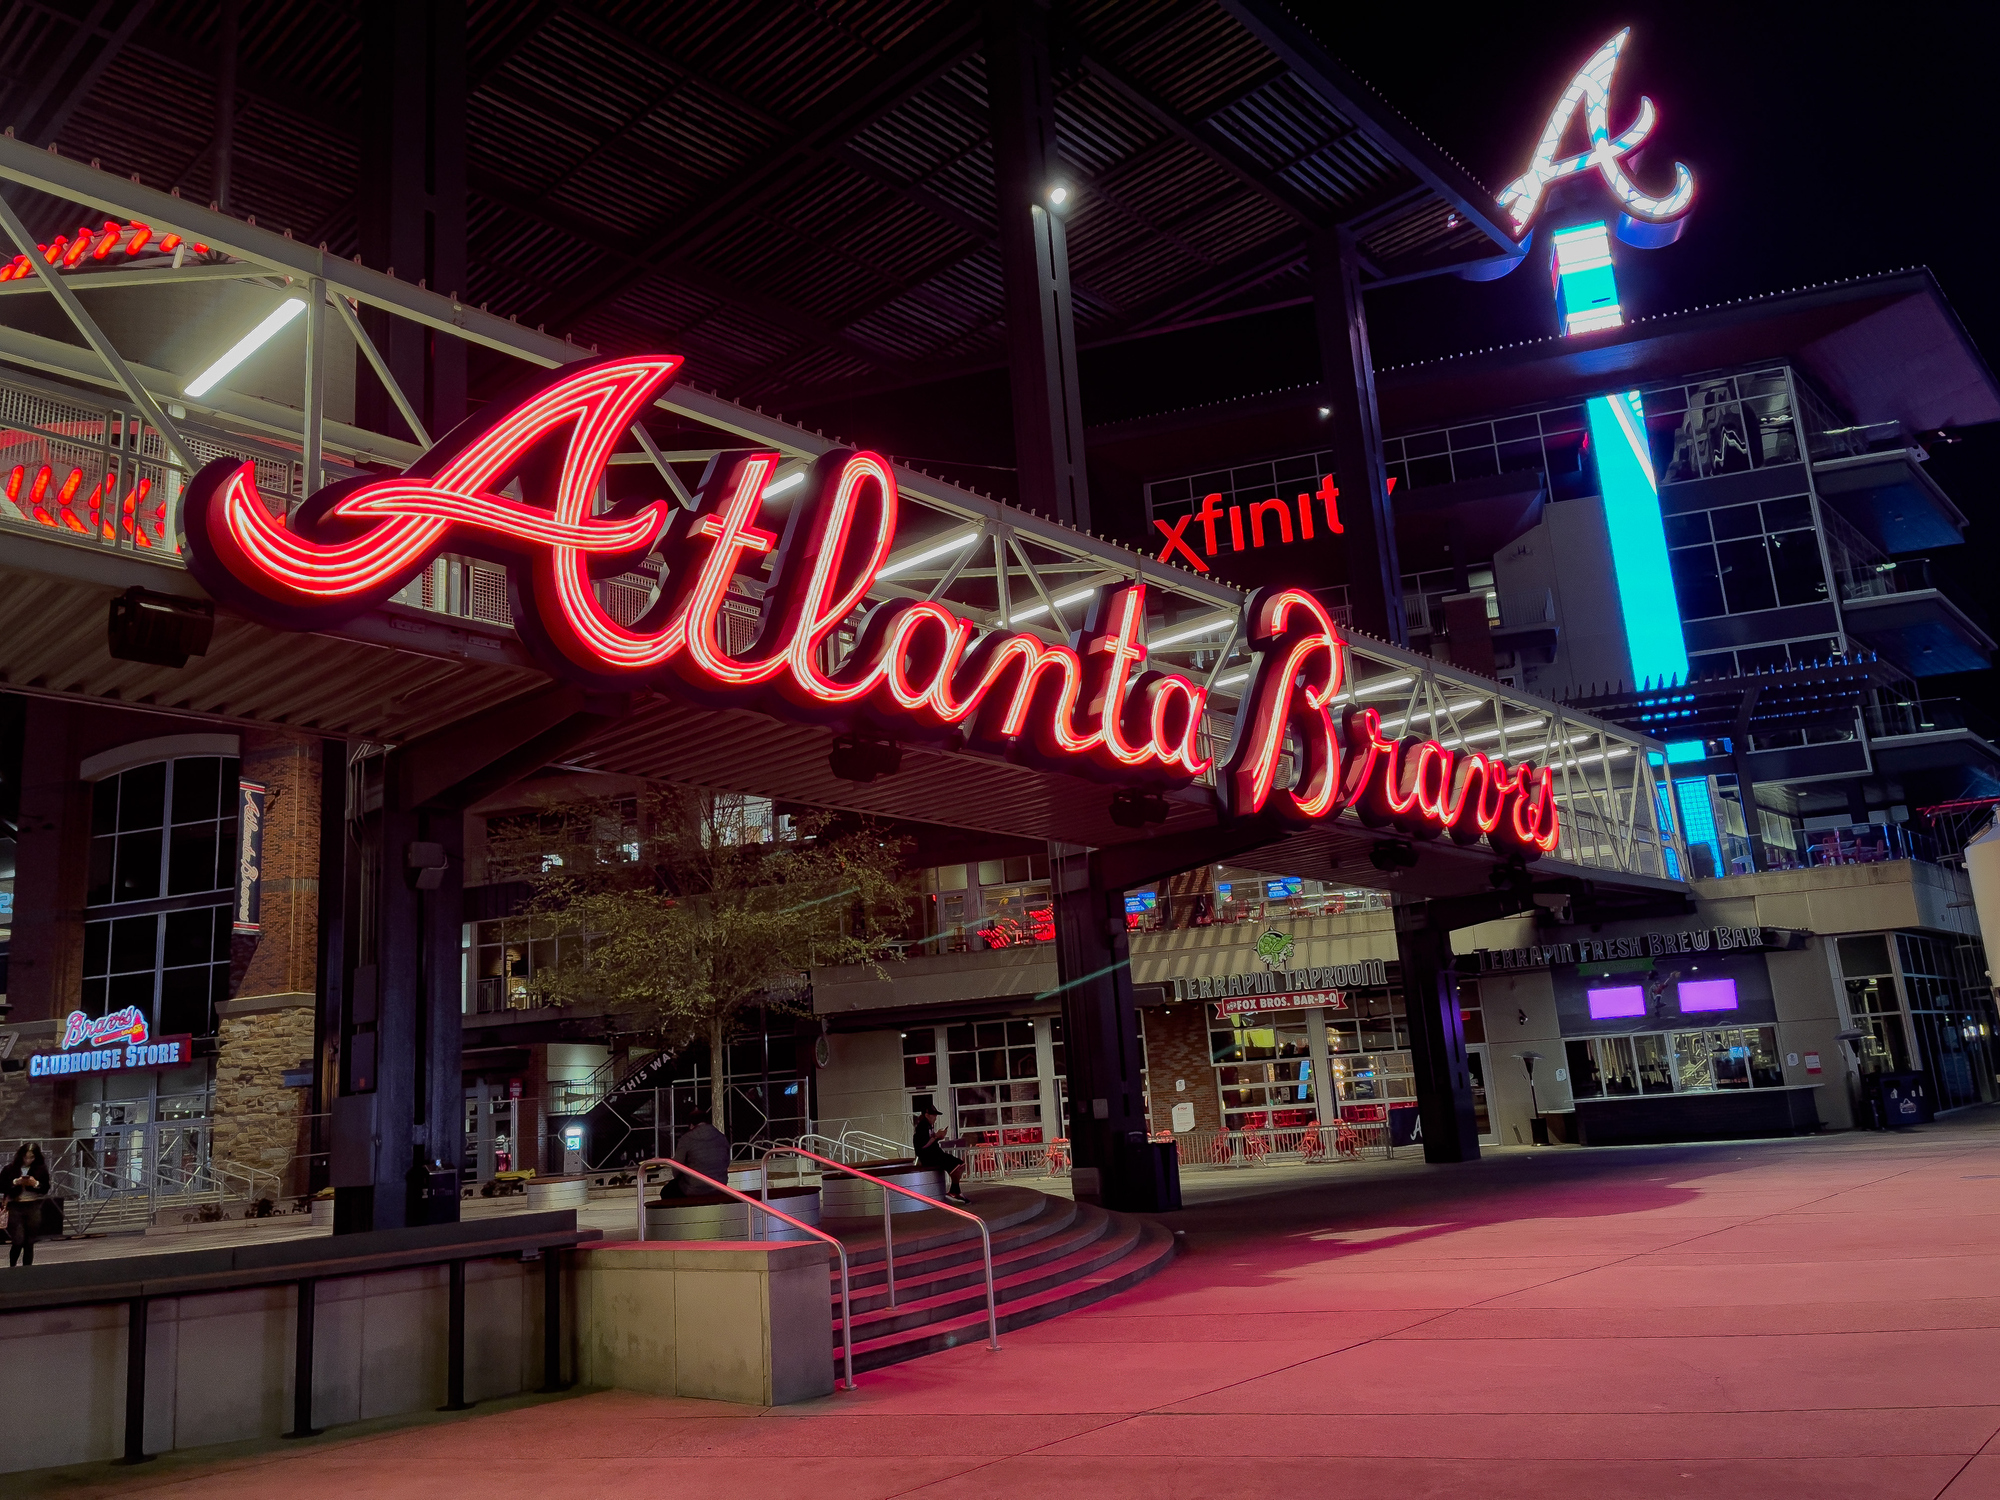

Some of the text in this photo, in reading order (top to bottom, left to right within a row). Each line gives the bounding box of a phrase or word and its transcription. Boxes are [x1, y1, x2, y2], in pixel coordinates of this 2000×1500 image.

[1497, 26, 1695, 236] A
[1152, 473, 1397, 573] xfinit
[205, 354, 1561, 851] Atlanta Braves
[239, 790, 260, 923] Atlanta Braves
[1577, 937, 1644, 963] FRESH
[1647, 930, 1711, 957] BREW
[1713, 925, 1764, 950] BAR
[1169, 970, 1277, 1002] TERRAPIN
[1237, 999, 1258, 1010] FOX
[1259, 997, 1291, 1009] BROS.
[1293, 993, 1337, 1006] BAR-B-Q
[62, 1005, 136, 1050] Braves
[30, 1042, 181, 1077] CLUBHOUSE STORE
[620, 1047, 677, 1095] THIS WAY
